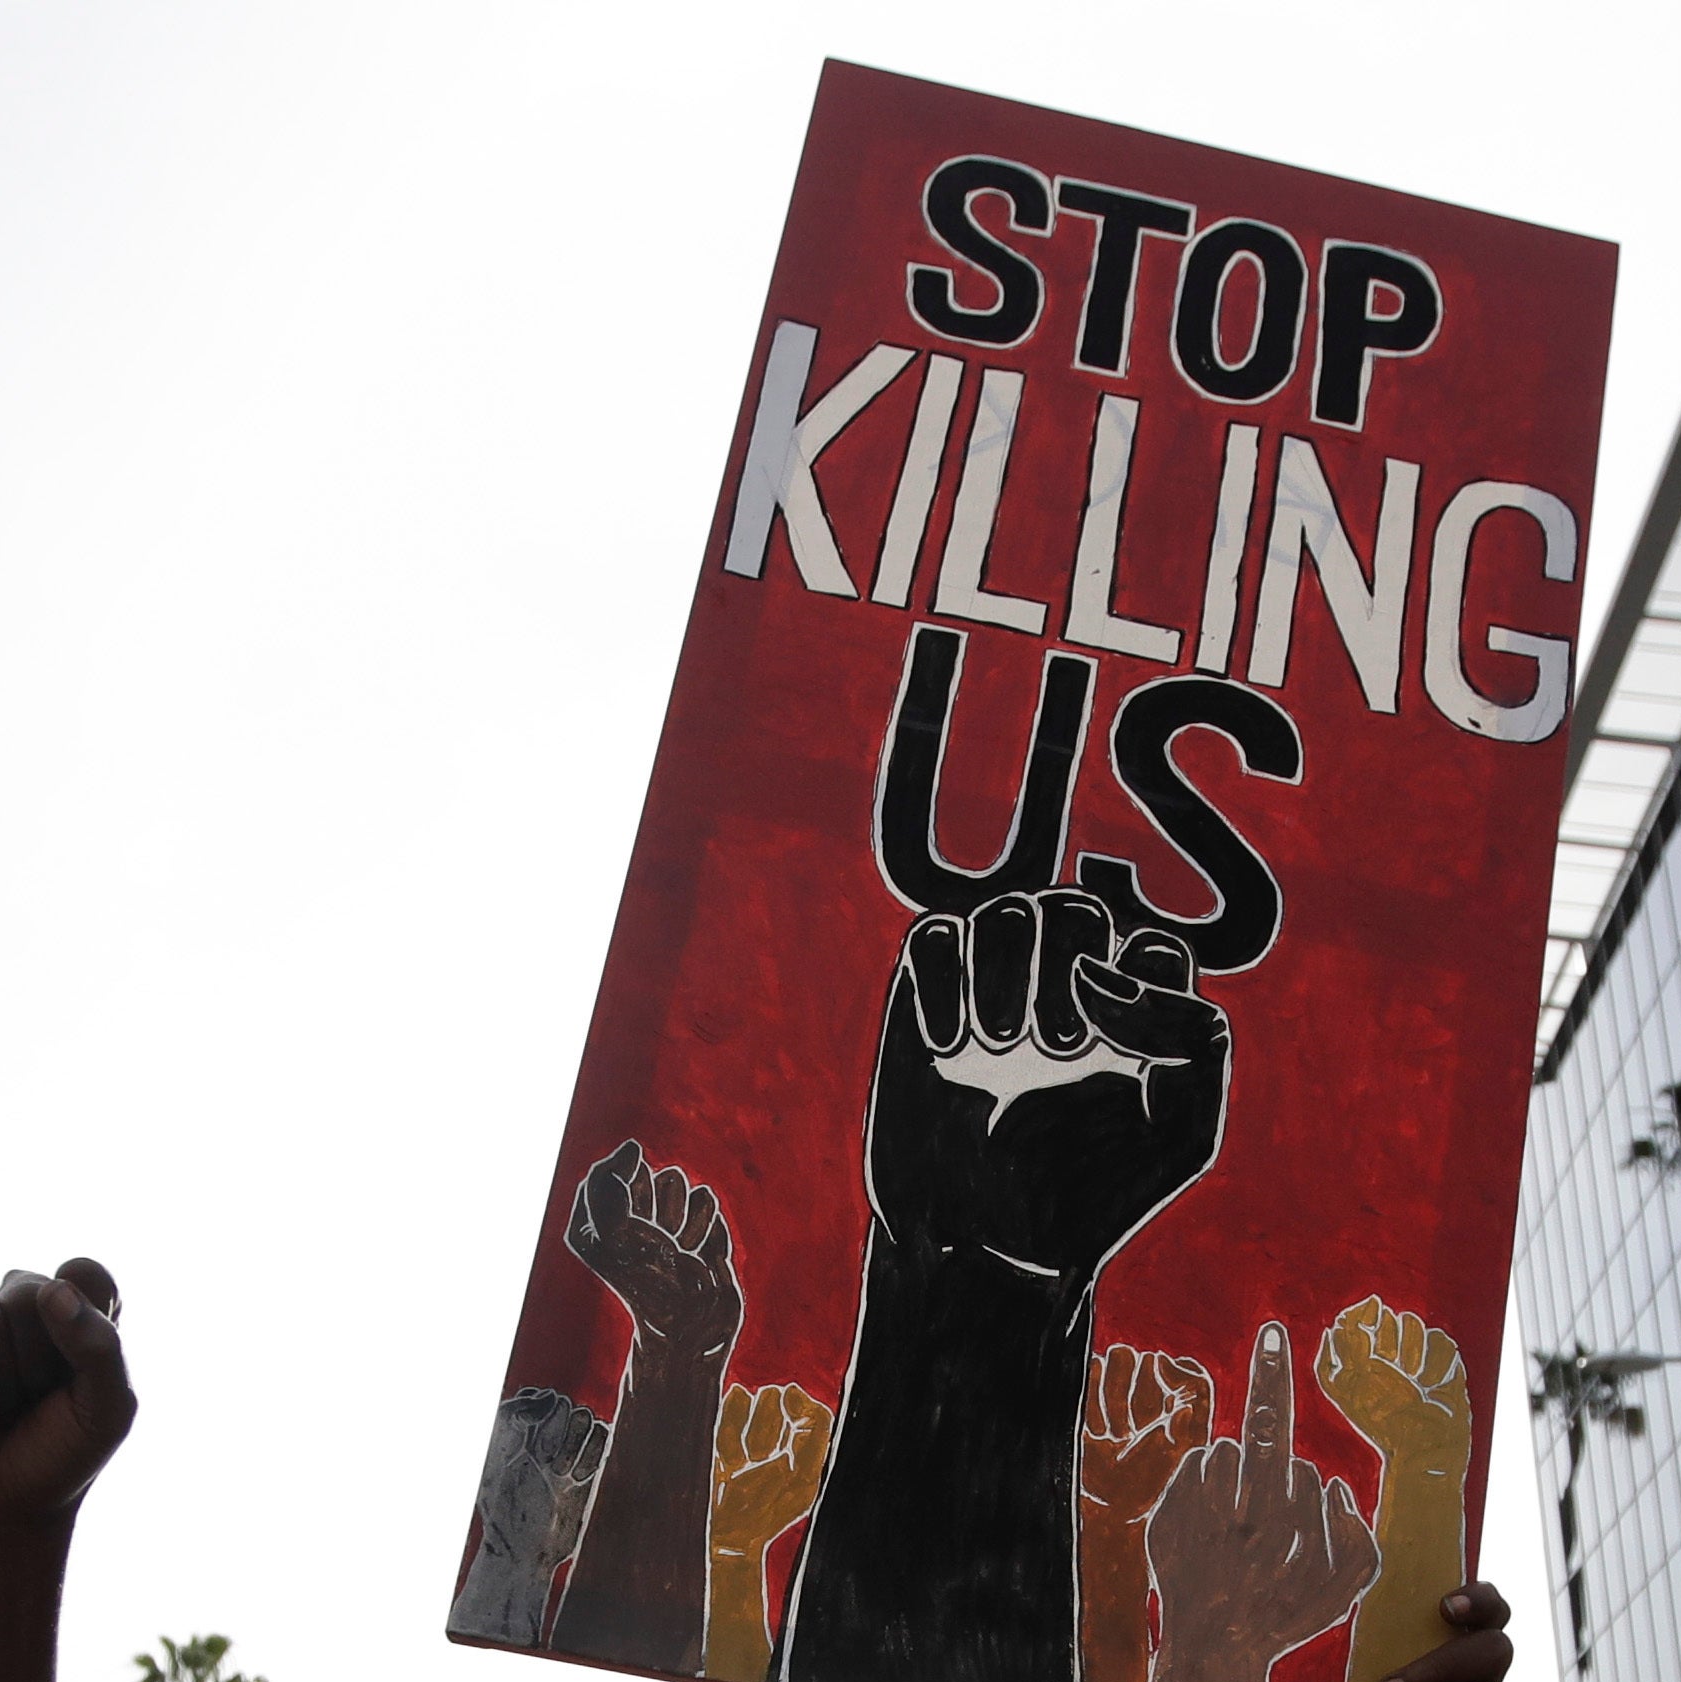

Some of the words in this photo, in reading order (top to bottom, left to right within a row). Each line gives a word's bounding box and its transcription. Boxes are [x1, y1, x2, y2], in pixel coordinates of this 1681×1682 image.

[905, 153, 1445, 432] STOP
[722, 319, 1579, 745] KILLING
[870, 621, 1306, 977] US
